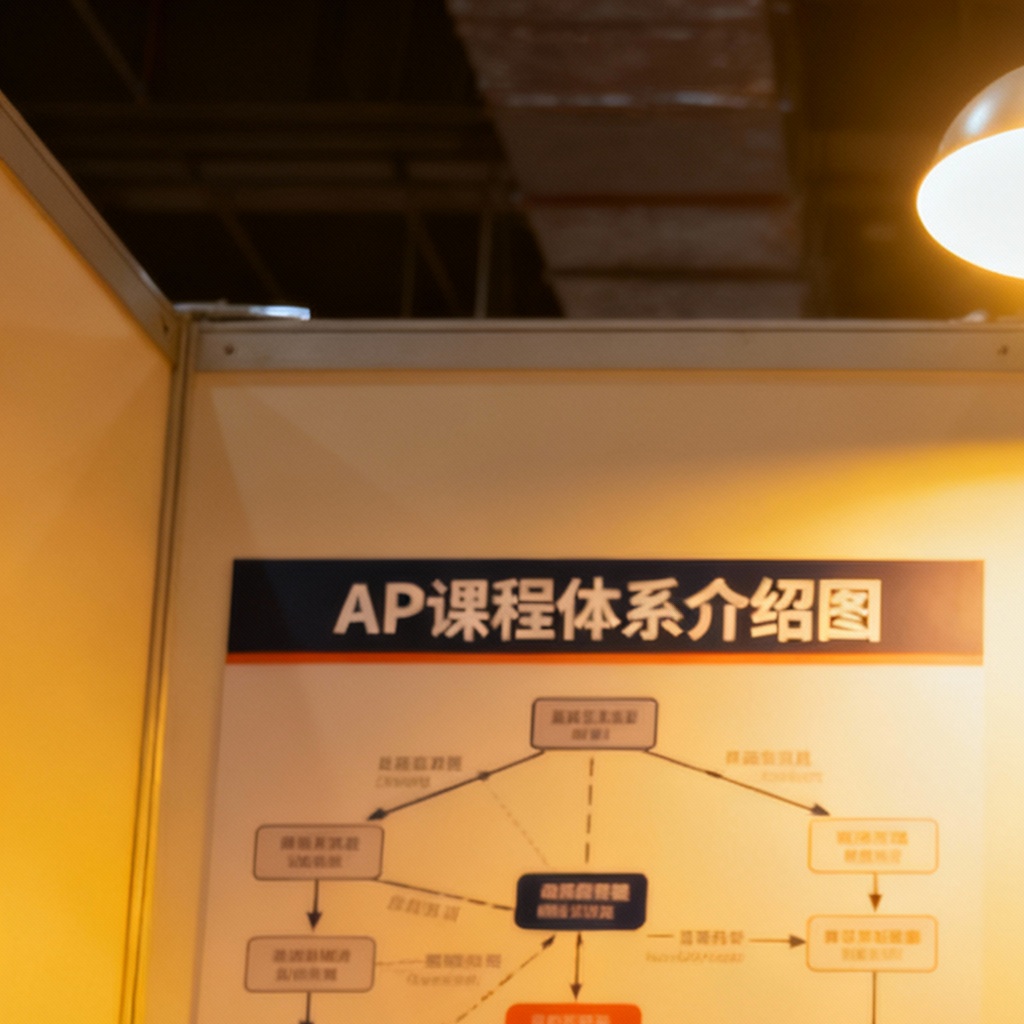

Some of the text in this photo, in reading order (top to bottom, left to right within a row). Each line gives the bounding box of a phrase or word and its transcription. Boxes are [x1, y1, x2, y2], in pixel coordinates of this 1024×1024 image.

[333, 576, 883, 643] AP课程体系介绍图
